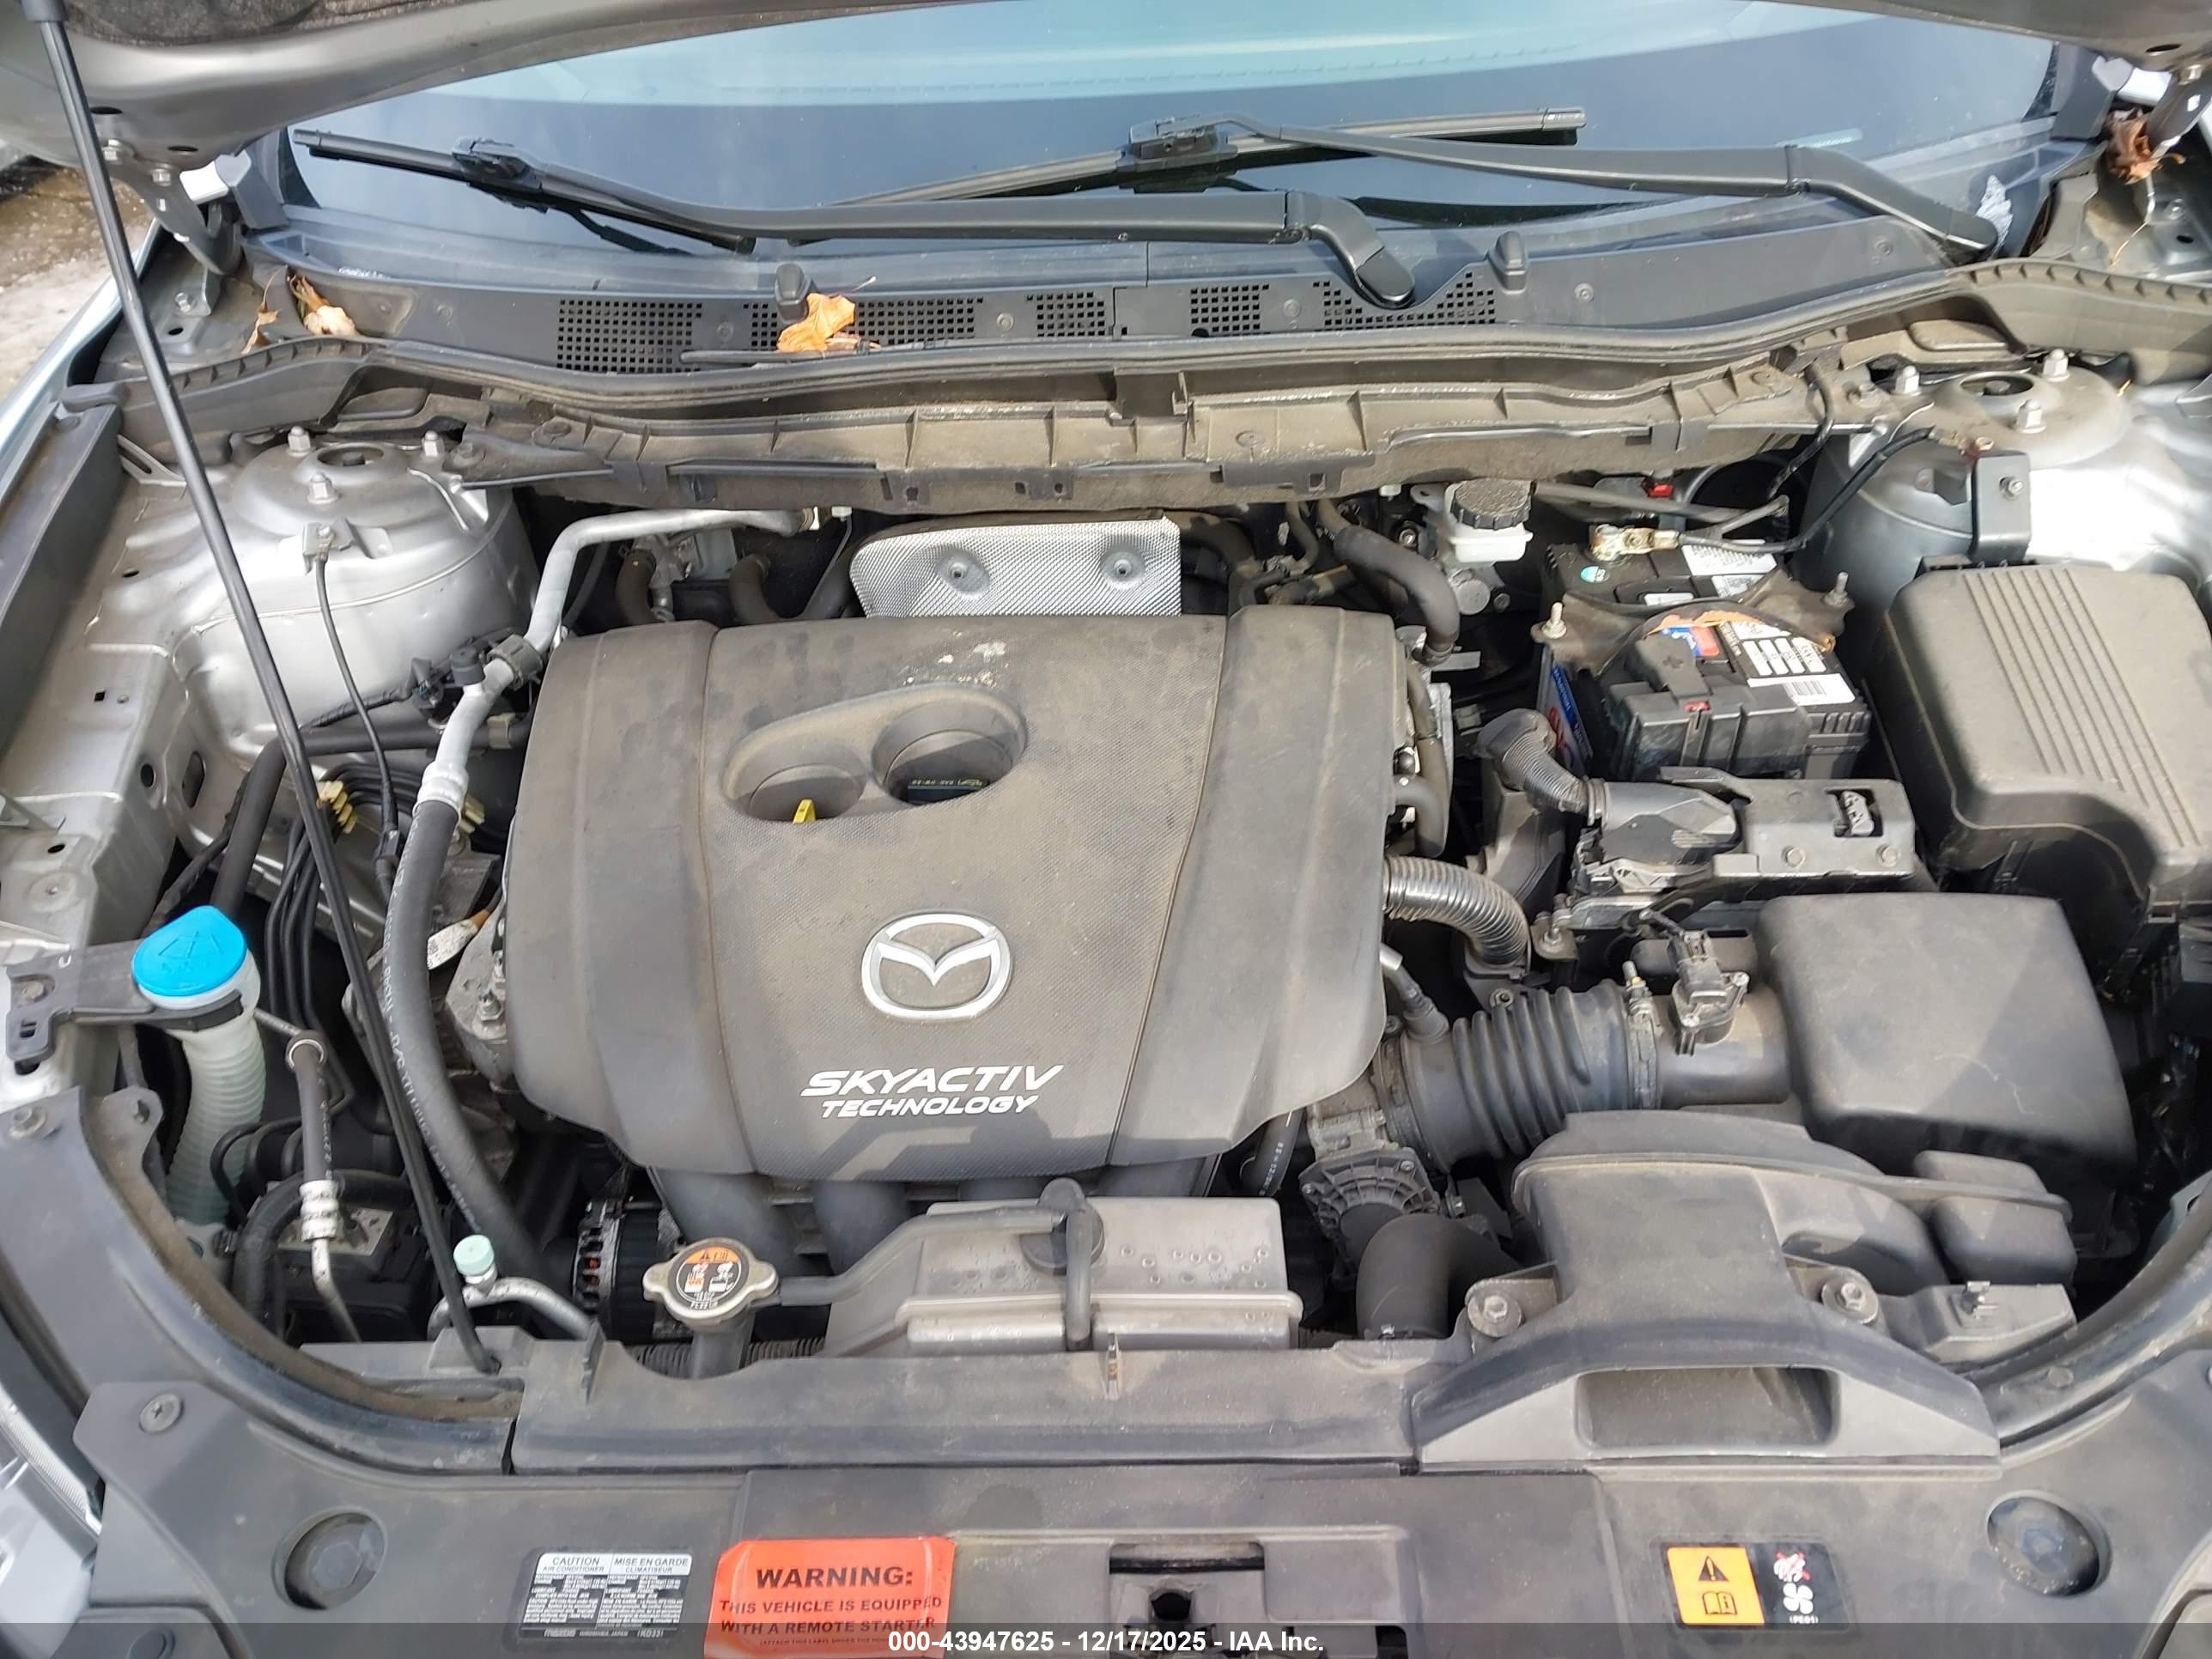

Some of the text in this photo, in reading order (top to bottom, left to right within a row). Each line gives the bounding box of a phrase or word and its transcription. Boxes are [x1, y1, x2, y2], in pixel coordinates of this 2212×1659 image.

[799, 1065, 1064, 1097] SKYACTIV
[822, 1095, 1039, 1118] TECHNOLOGY
[614, 1558, 688, 1566] MISE EN GARDE
[756, 1566, 914, 1589] WARNING:
[720, 1596, 942, 1614] THIS VEHICLE IS EQUIPPED
[720, 1616, 936, 1635] WITH A REMOTE STARTER
